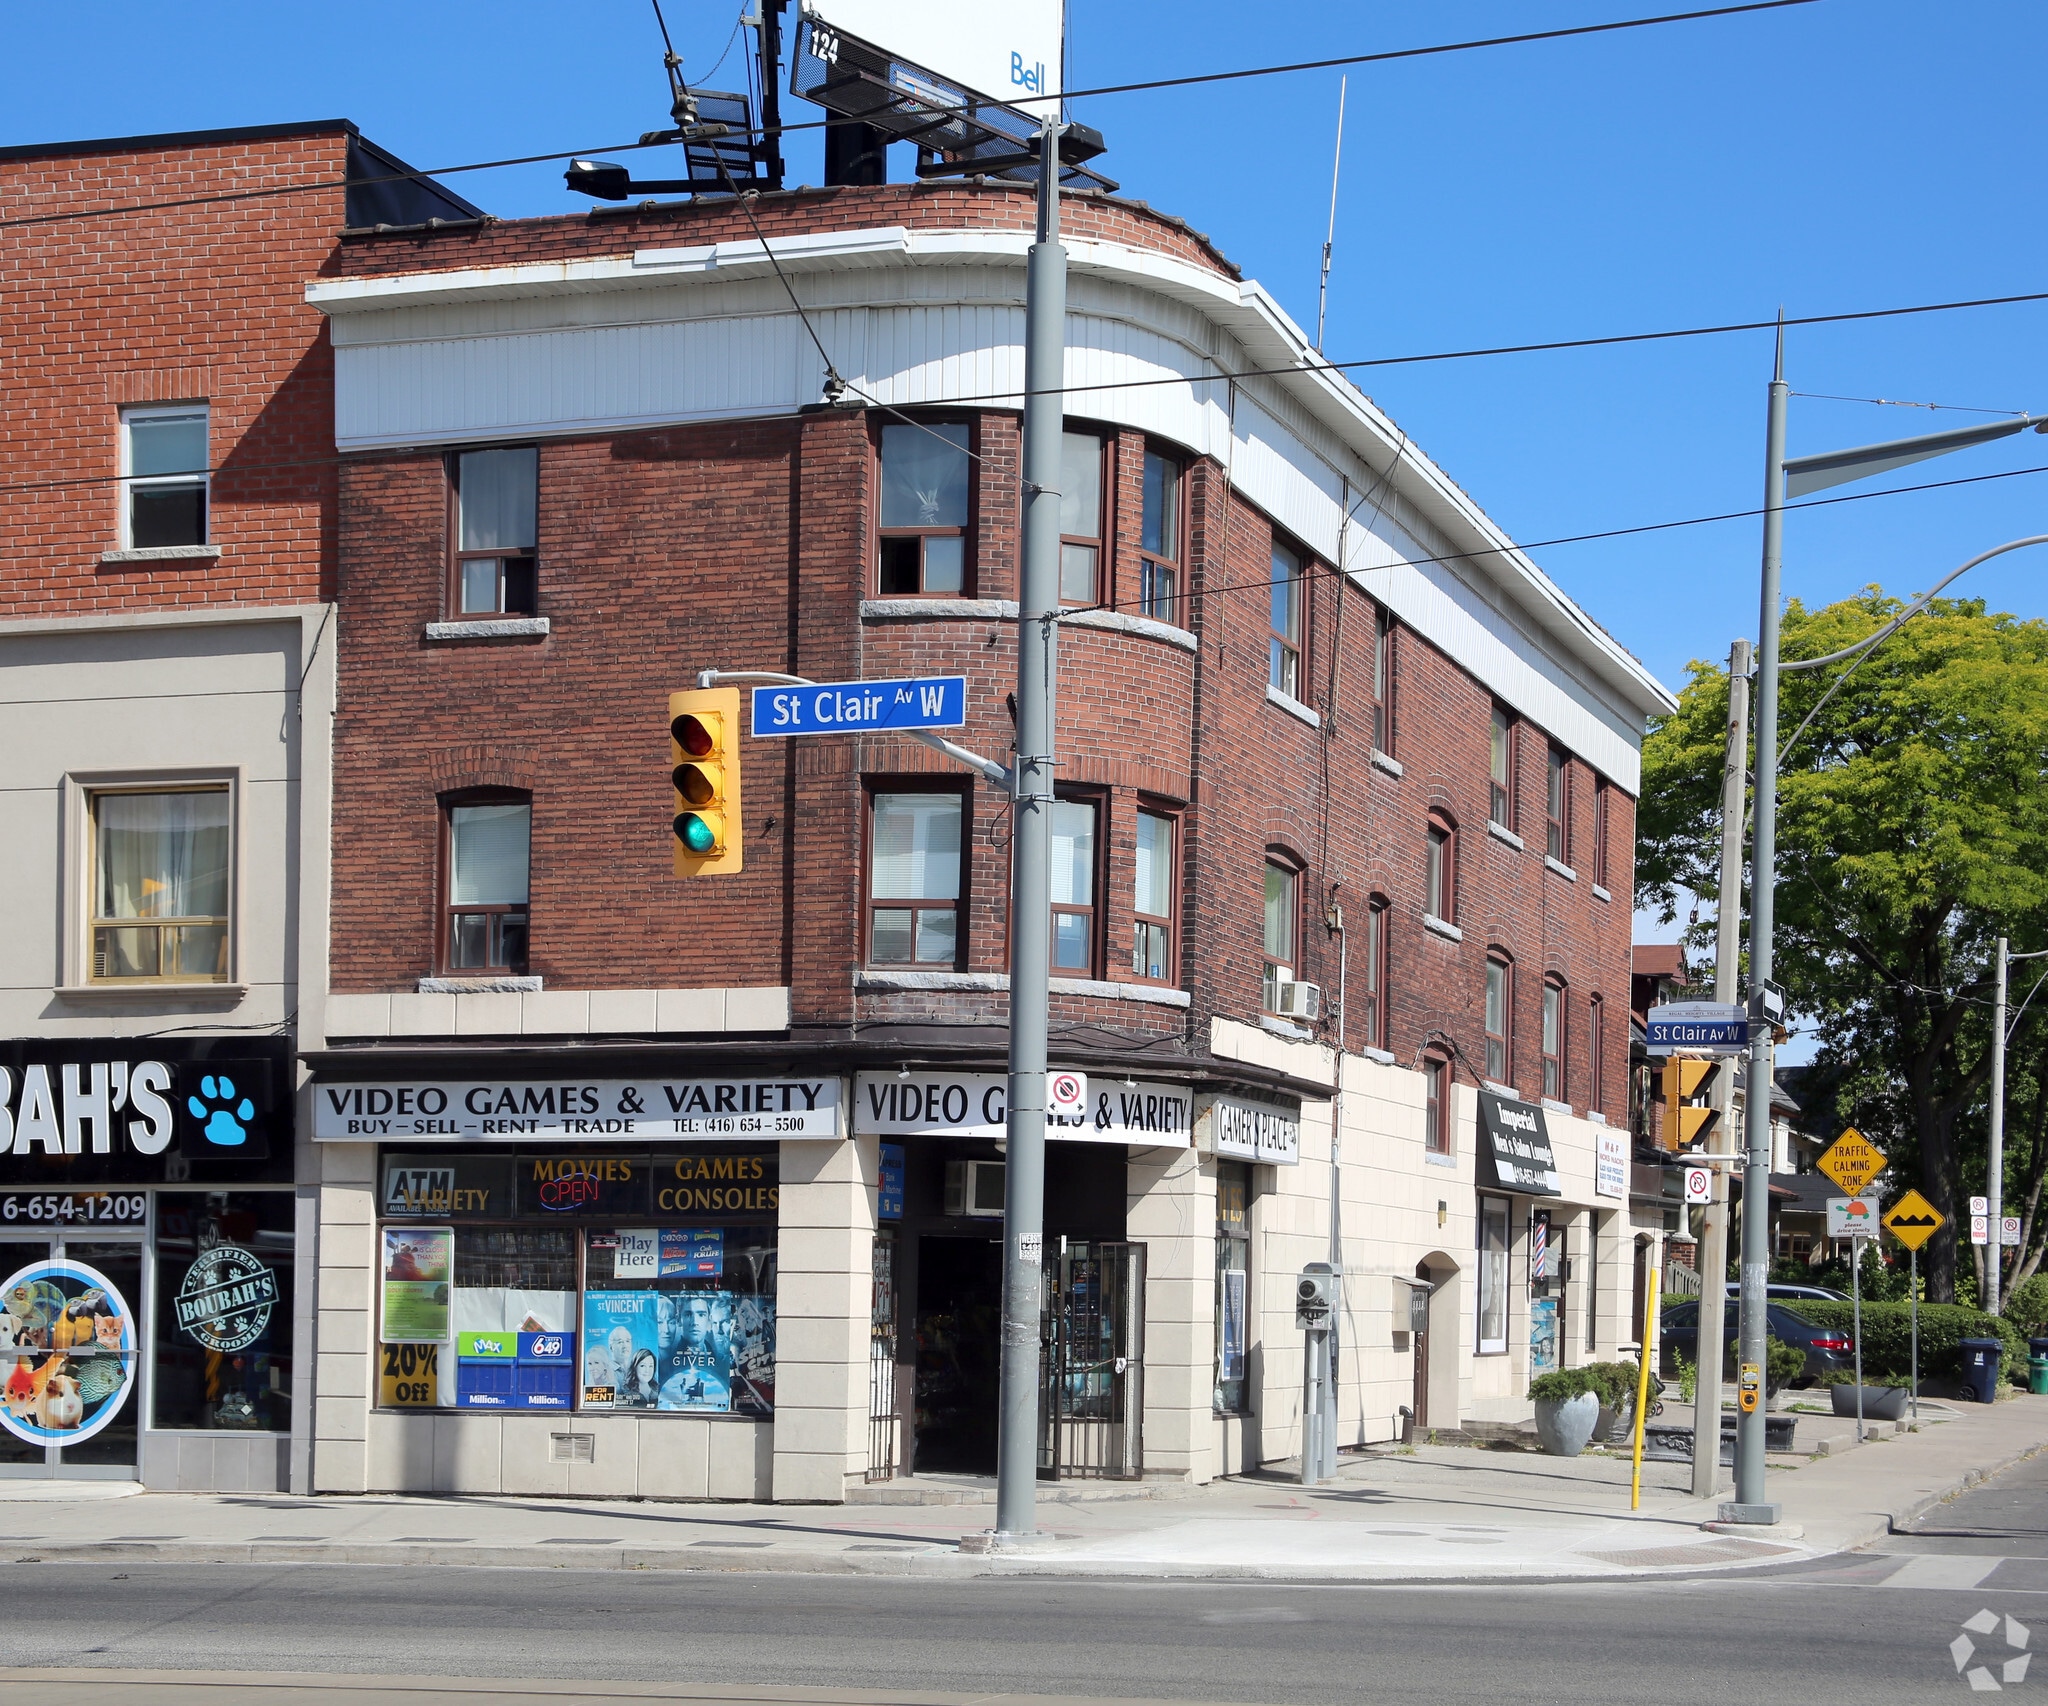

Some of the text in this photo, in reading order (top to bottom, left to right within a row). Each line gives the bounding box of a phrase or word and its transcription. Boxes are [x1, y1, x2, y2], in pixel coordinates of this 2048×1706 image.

[812, 30, 839, 64] 124
[1011, 50, 1045, 96] Bell
[773, 685, 945, 725] St Clair Av W
[1654, 1025, 1739, 1041] St Clair Av W
[327, 1083, 823, 1116] VIDEO GAMES & VARIETY
[868, 1083, 968, 1123] VIDEO
[1095, 1092, 1113, 1129] &
[1120, 1092, 1188, 1135] VARIETY
[348, 1119, 392, 1134] BUY
[413, 1119, 460, 1134] SELL
[482, 1119, 540, 1134] RENT
[561, 1118, 635, 1134] TRADE
[673, 1118, 699, 1133] TEL:
[704, 1117, 735, 1134] (416)
[1220, 1104, 1288, 1151] GAMER'S PLACE
[1496, 1101, 1538, 1132] Imperial
[1512, 1136, 1532, 1159] Salon
[1834, 1145, 1869, 1157] TRAFFIC
[533, 1159, 631, 1182] MOVIES
[675, 1157, 763, 1180] GAMES
[1833, 1160, 1870, 1172] CALMING
[391, 1171, 450, 1200] ATM
[540, 1181, 598, 1203] OPEN
[1841, 1175, 1863, 1187] ZONE
[403, 1189, 489, 1211] VARIETY
[658, 1187, 779, 1210] CONSOLES
[622, 1235, 653, 1254] Play
[187, 1250, 257, 1287] CERTIFIED
[619, 1252, 654, 1266] Here
[180, 1277, 273, 1322] BOUBAH'S
[605, 1299, 645, 1313] VINCENT
[200, 1313, 267, 1349] GROOMER
[383, 1344, 437, 1379] 20%
[672, 1355, 716, 1367] GIVER
[395, 1382, 429, 1402] Off
[585, 1392, 614, 1402] RENT
